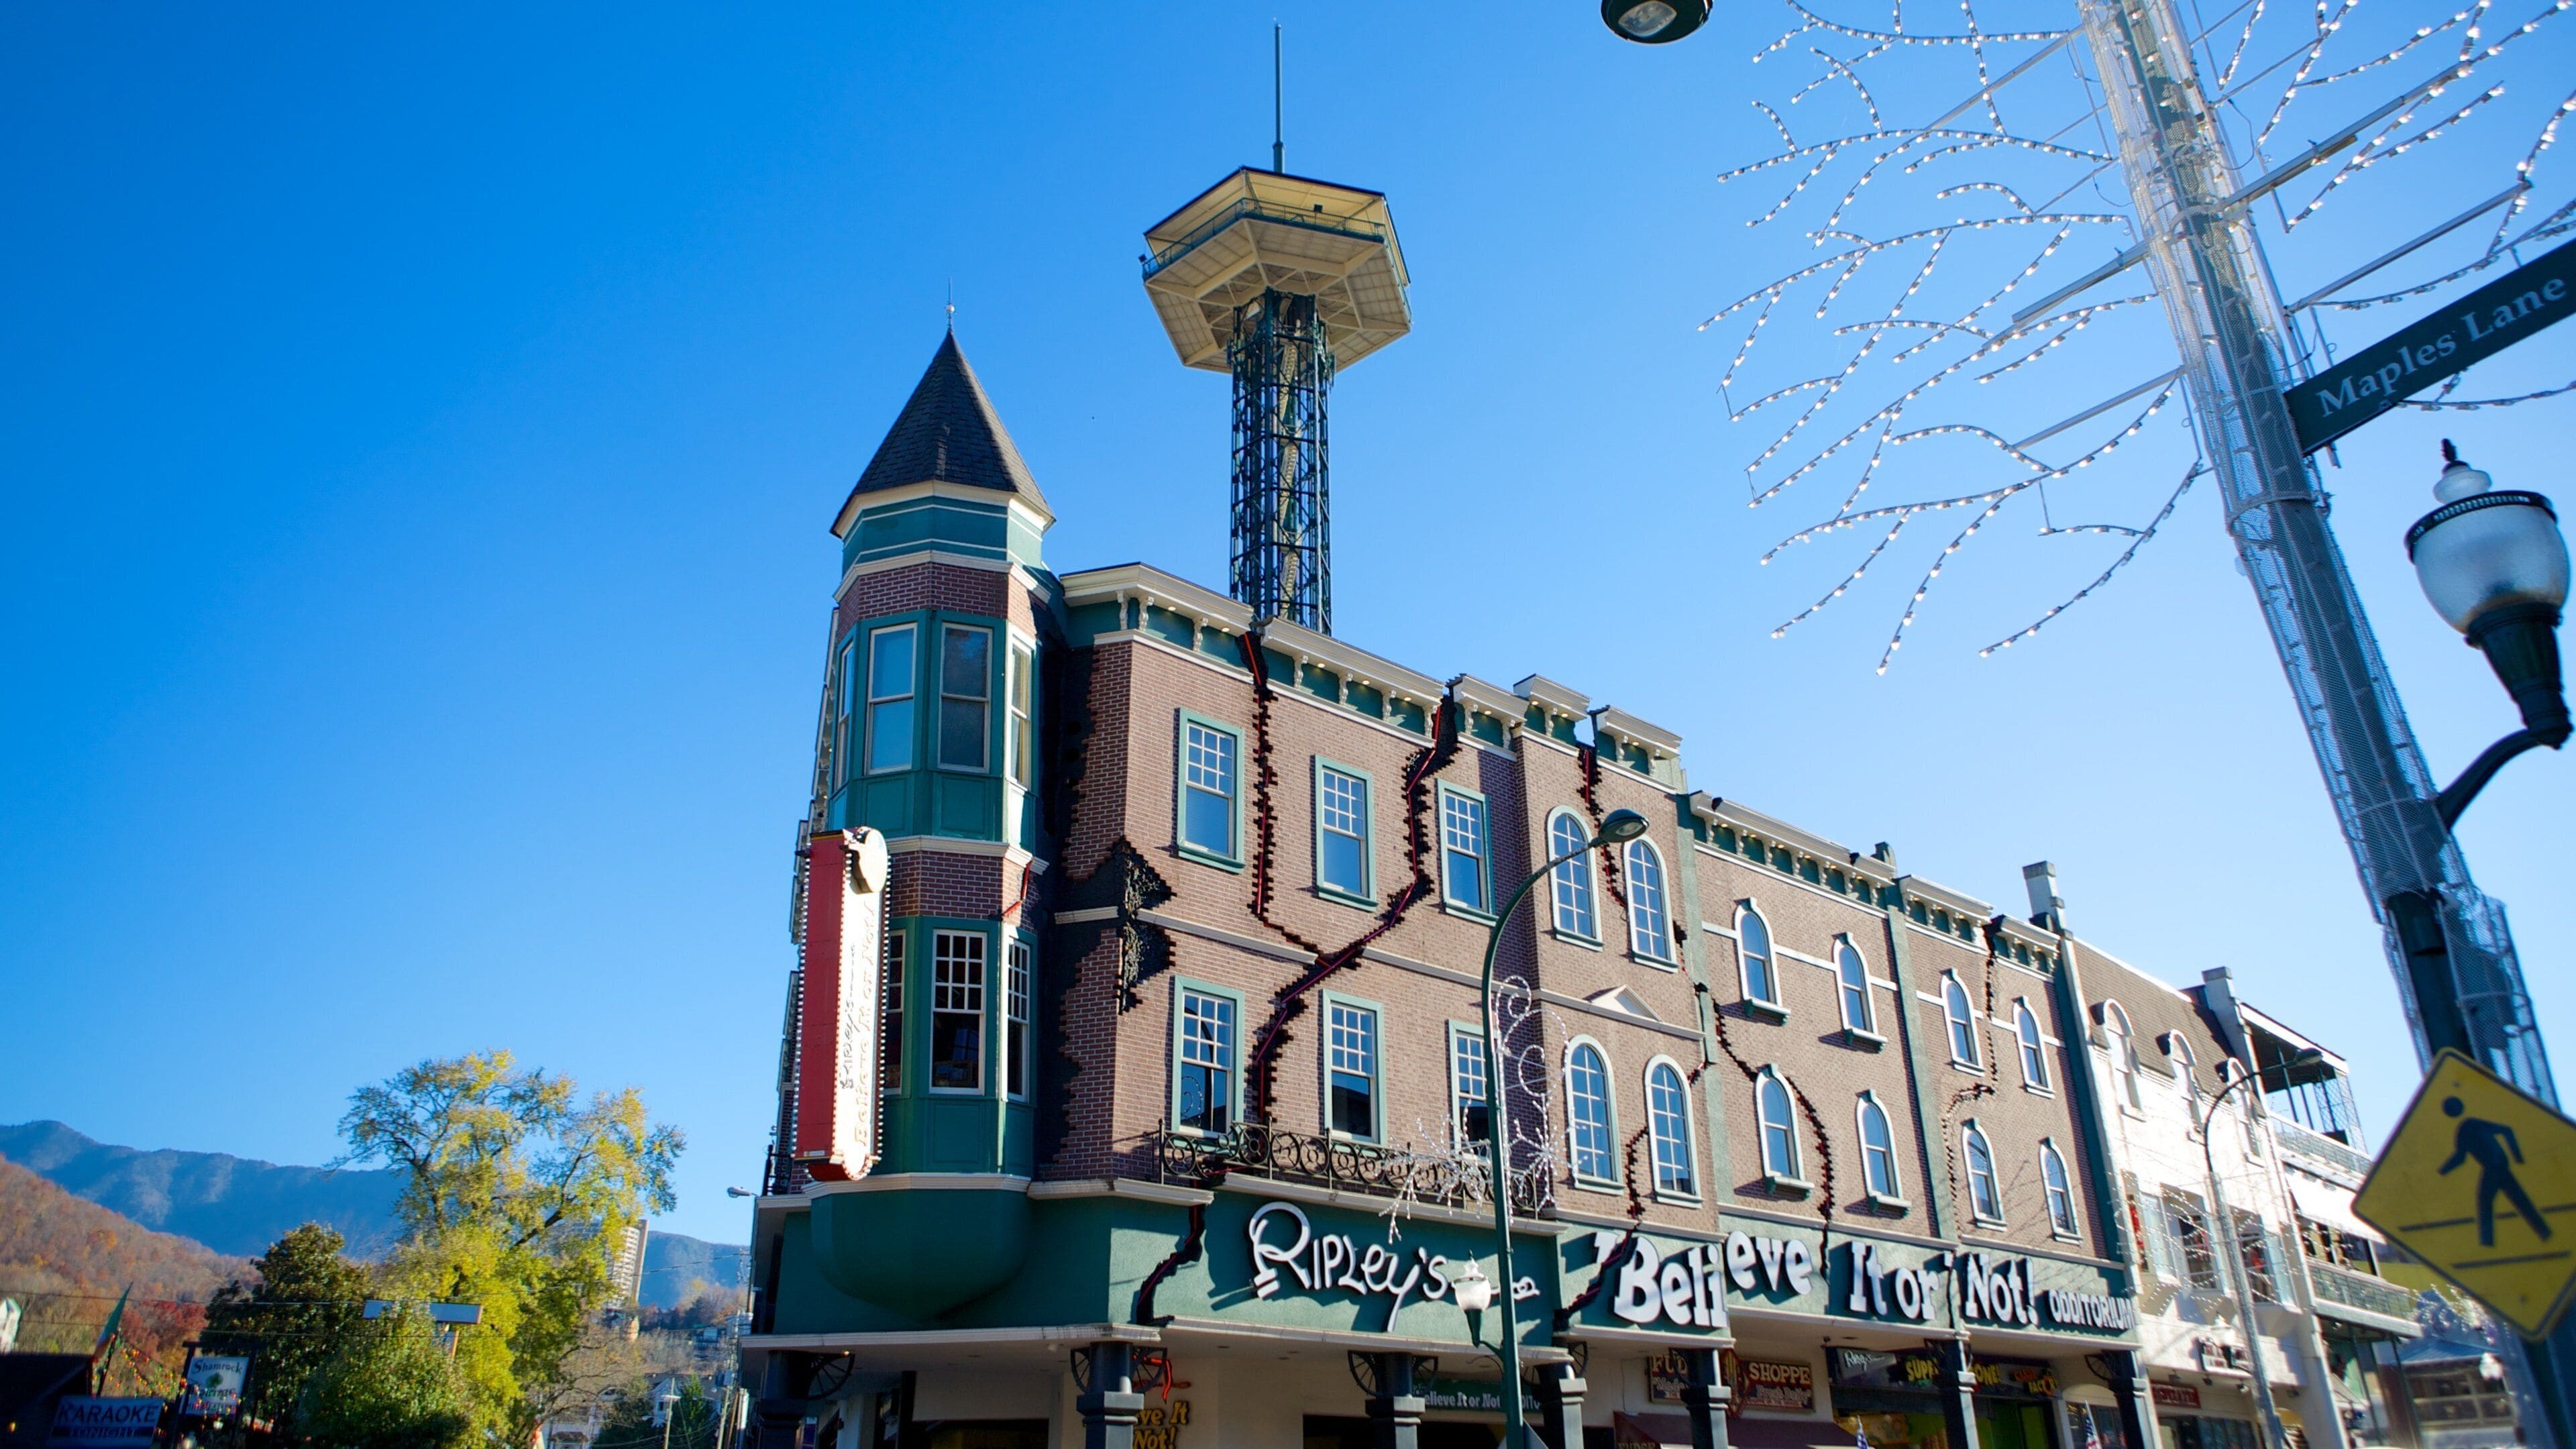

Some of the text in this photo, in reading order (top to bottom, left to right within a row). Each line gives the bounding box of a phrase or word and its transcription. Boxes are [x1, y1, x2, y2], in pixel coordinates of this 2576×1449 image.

[2316, 278, 2567, 418] Maples Lane
[1595, 1230, 2136, 1330] Believe It or Not! ODDITORIUM
[192, 1358, 242, 1375] Shamrock
[1652, 1354, 1811, 1384] FUD SHOPPE
[1970, 1363, 2002, 1385] ONE!
[1425, 1391, 1456, 1407] elieve
[1457, 1391, 1468, 1407] It
[1468, 1395, 1481, 1407] or
[58, 1405, 159, 1423] KARAOKE
[1169, 1400, 1189, 1425] It
[70, 1426, 135, 1438] TONIGHT
[1132, 1426, 1179, 1449] Not!
